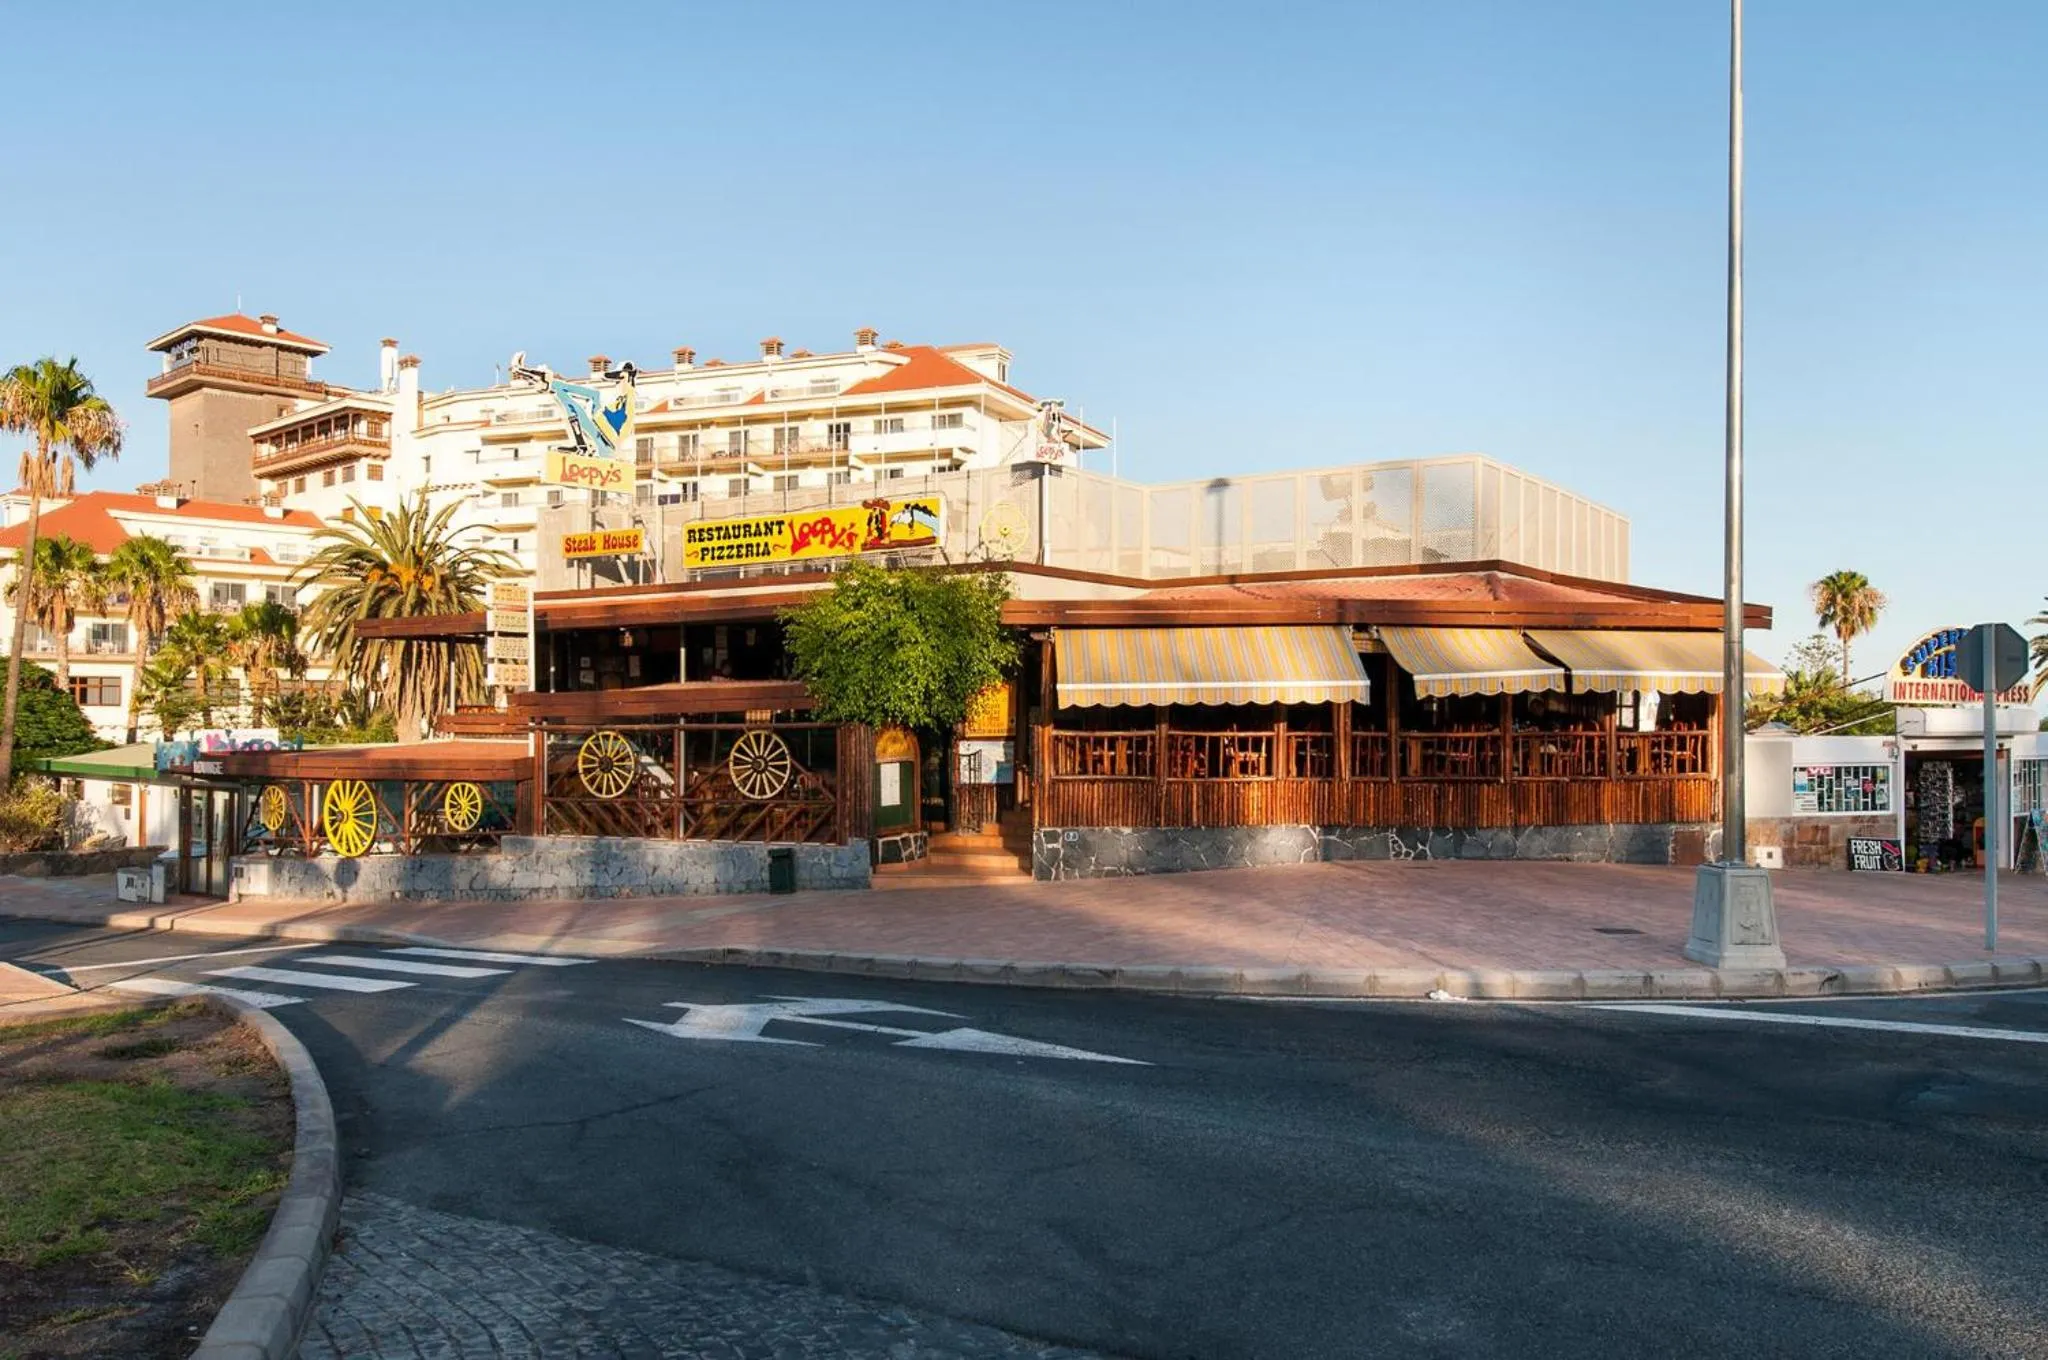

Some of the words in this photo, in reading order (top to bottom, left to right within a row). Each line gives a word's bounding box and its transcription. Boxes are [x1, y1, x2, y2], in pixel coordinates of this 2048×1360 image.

[560, 456, 622, 486] Loopy's
[687, 520, 785, 543] RESTAURANT
[565, 536, 596, 553] Steak
[603, 534, 639, 550] House
[700, 542, 771, 562] PIZZERIA
[1893, 681, 1985, 701] INTERNATION
[1850, 840, 1882, 855] FRESH
[1853, 855, 1881, 870] FRUIT
